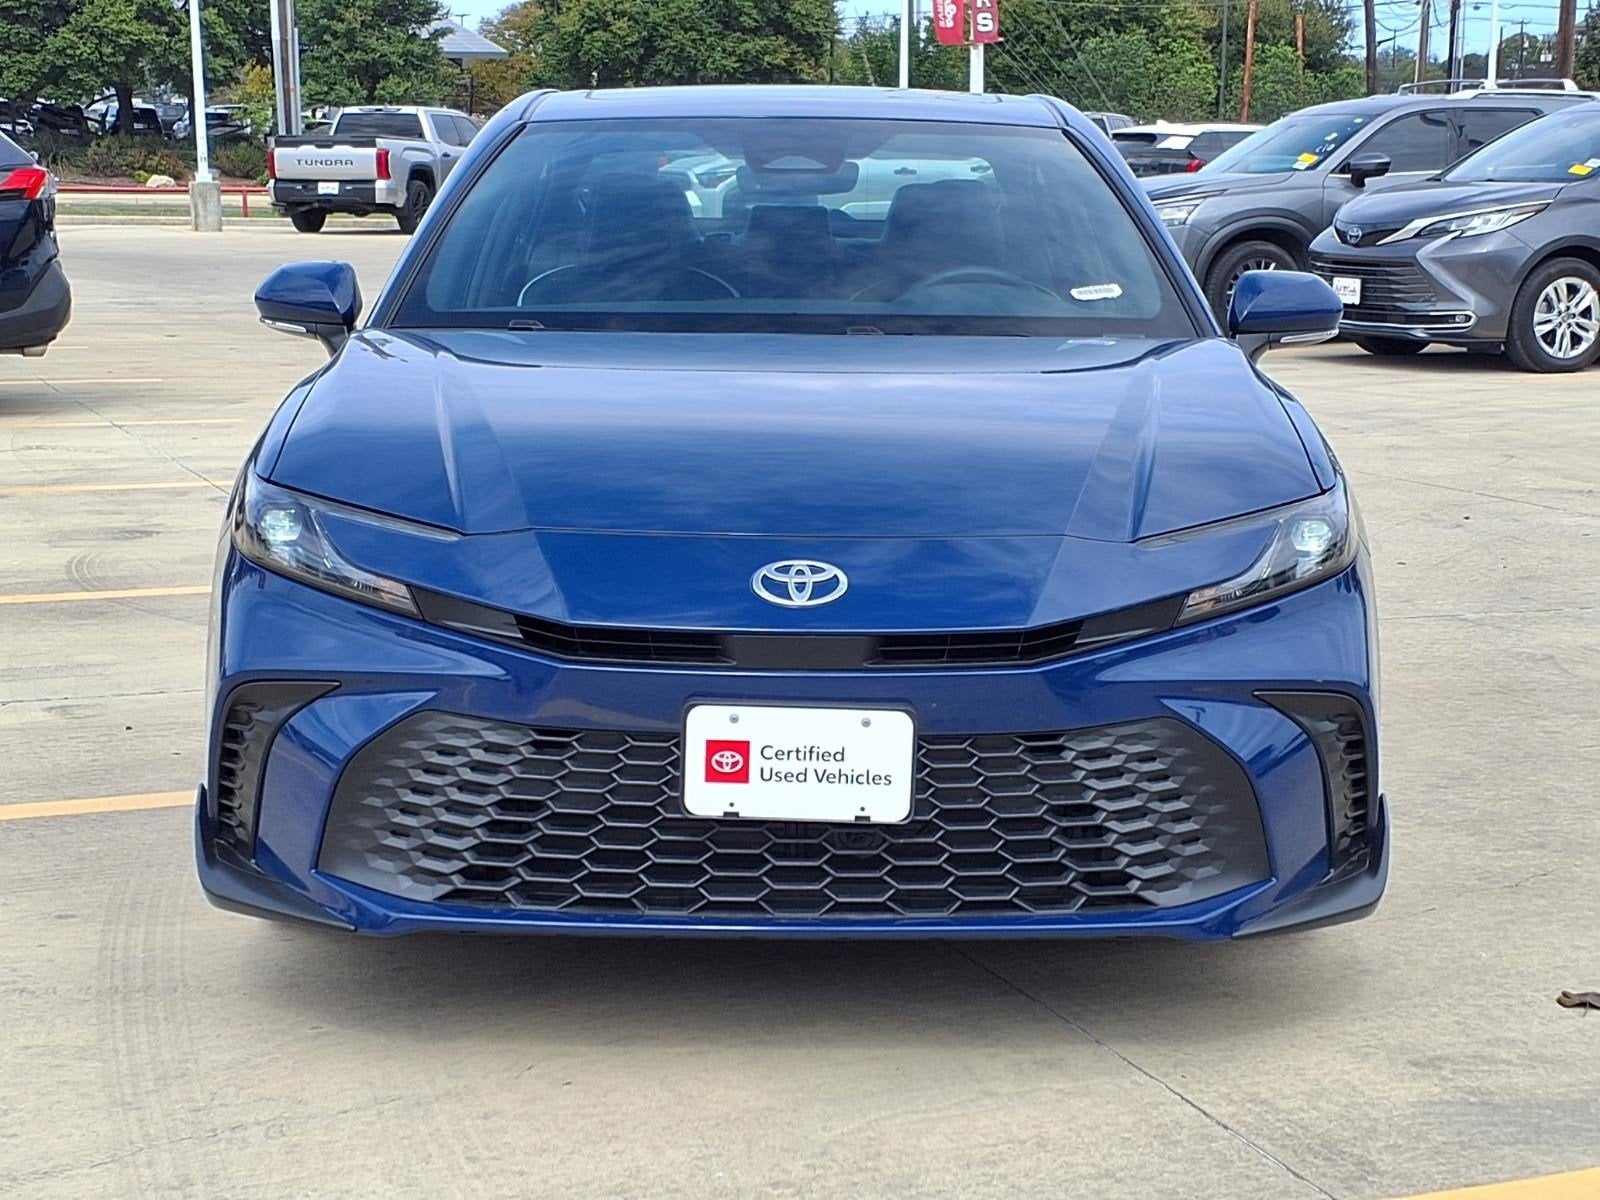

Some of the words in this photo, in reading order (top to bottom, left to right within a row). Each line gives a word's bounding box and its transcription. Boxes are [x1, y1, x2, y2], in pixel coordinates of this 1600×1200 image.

[296, 159, 354, 167] TUNDRA
[760, 745, 845, 762] Certified
[760, 767, 808, 783] Used
[814, 768, 892, 785] Vehicles
